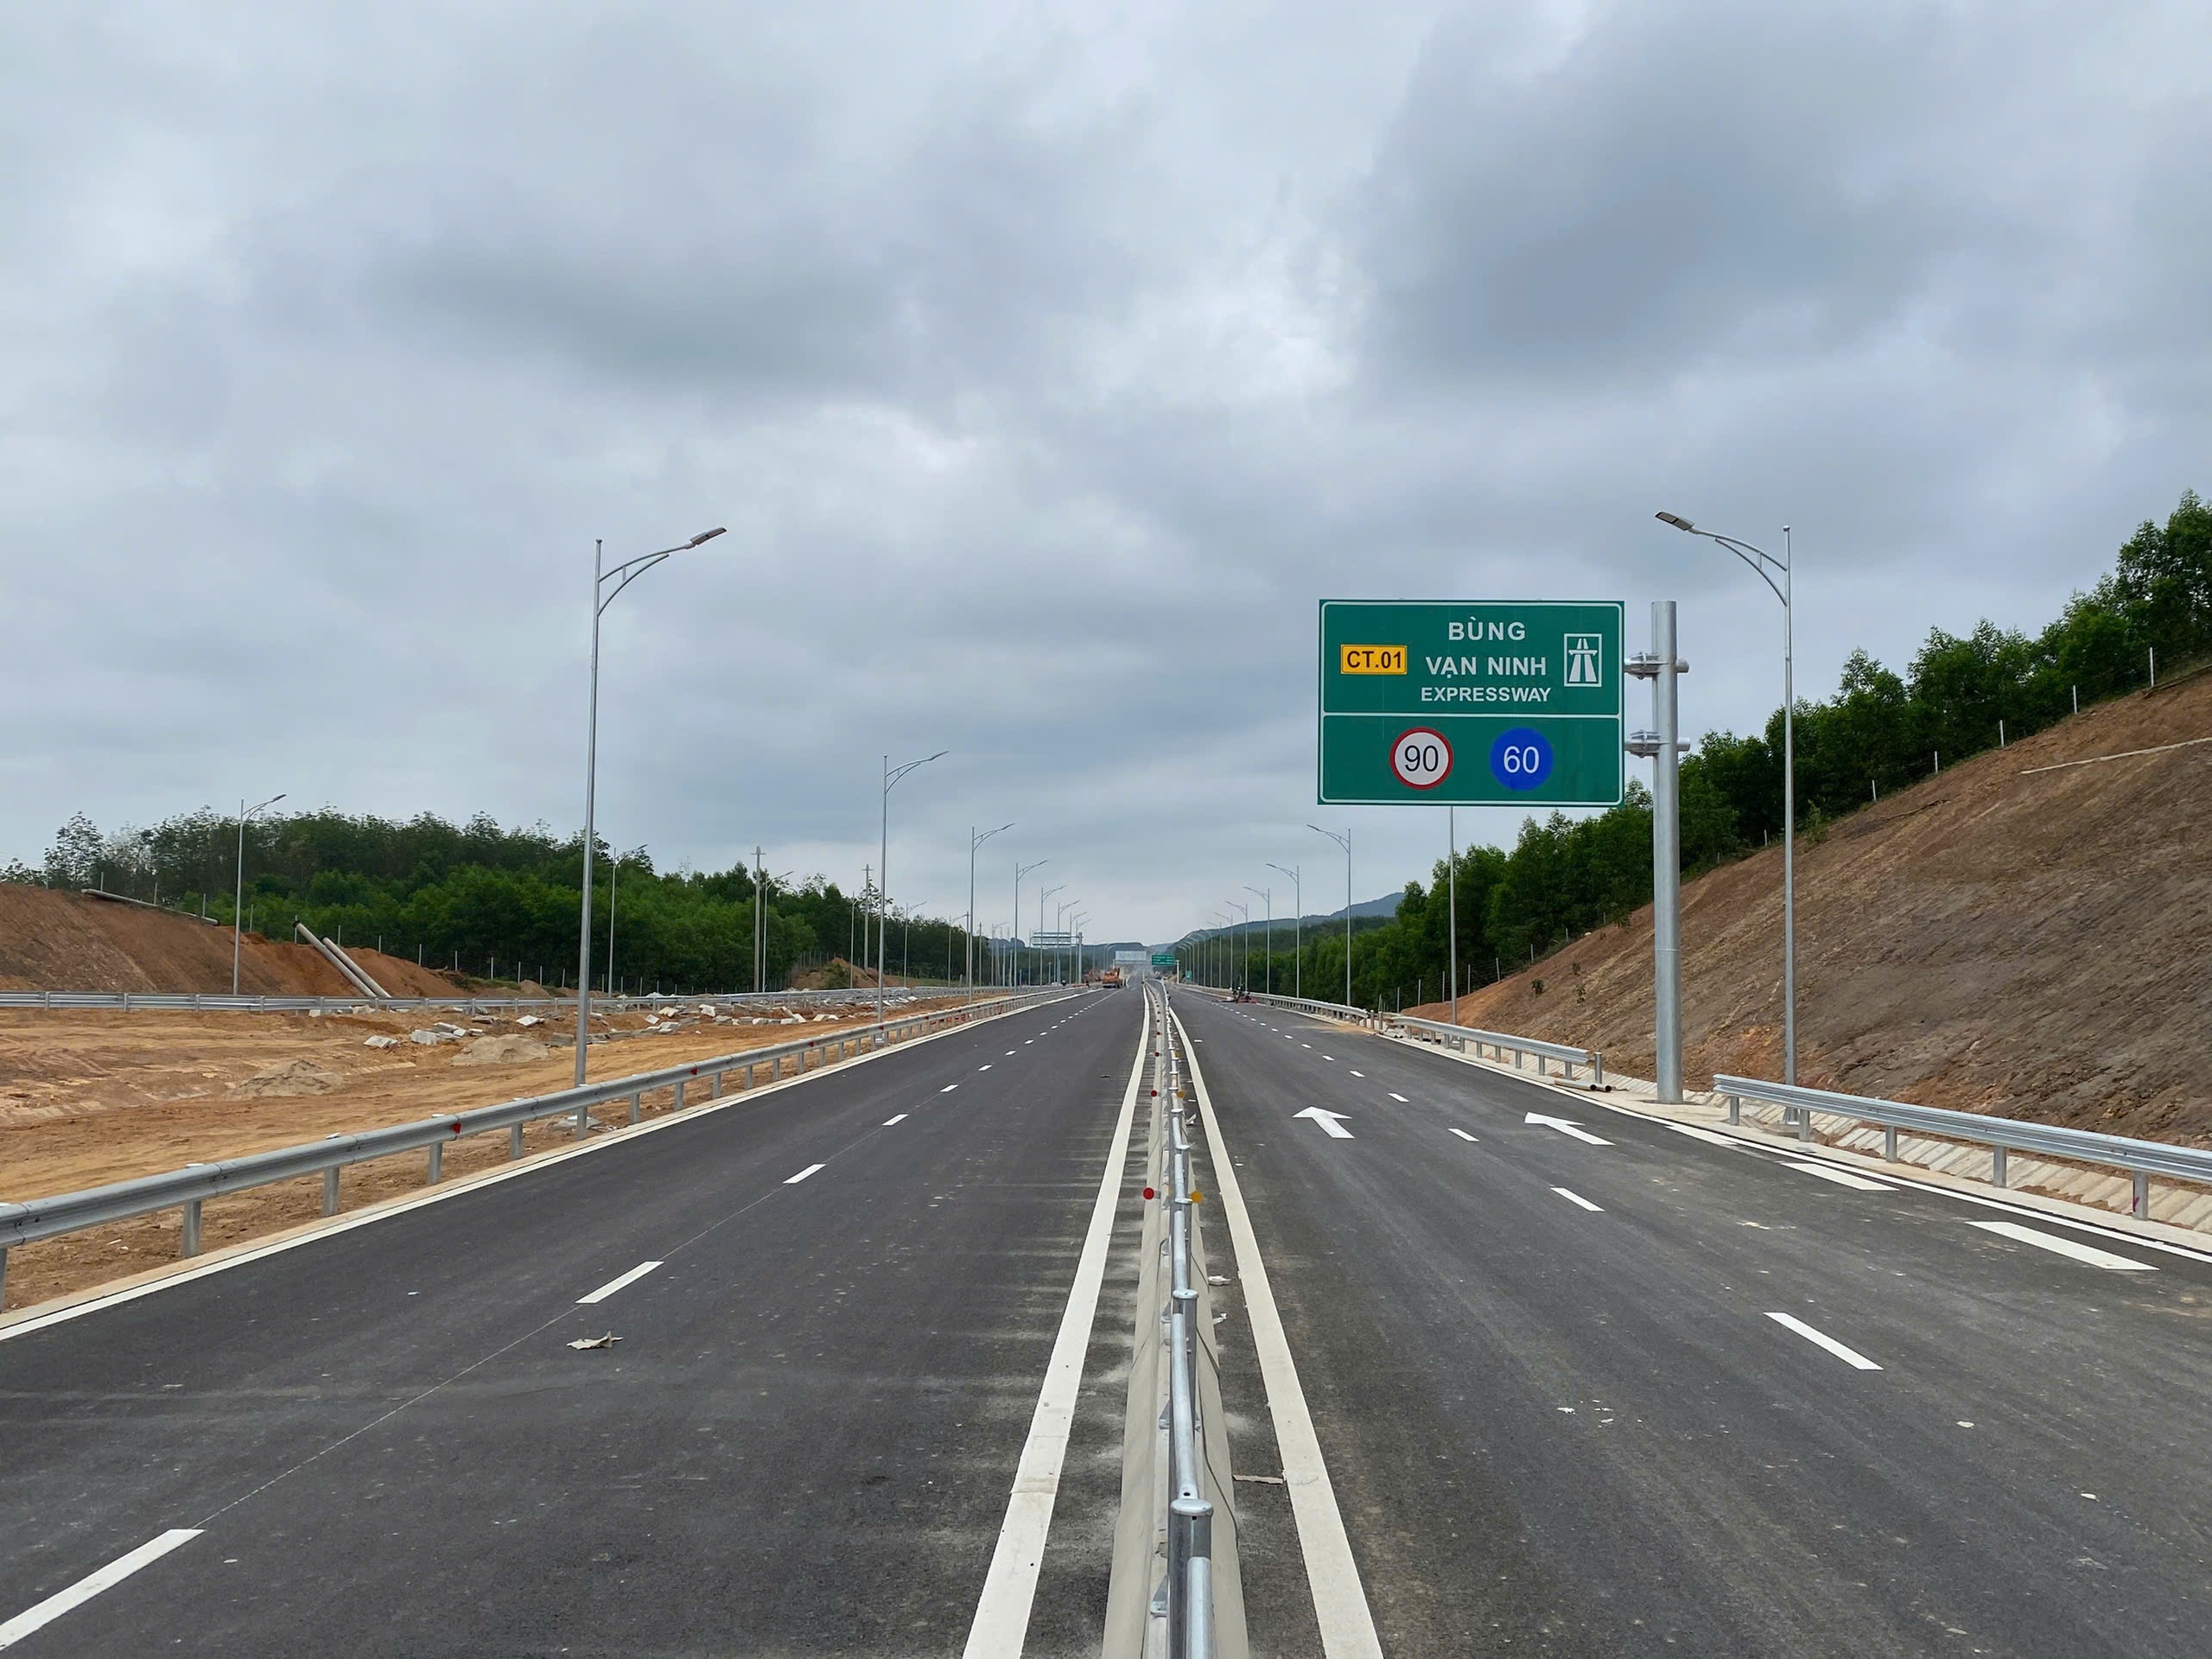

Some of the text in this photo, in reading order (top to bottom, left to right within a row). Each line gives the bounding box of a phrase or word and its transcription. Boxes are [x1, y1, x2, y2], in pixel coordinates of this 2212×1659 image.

[1448, 616, 1526, 641] BÙNG
[1346, 651, 1402, 670] CT.01
[1426, 657, 1547, 678] VẠN NINH
[1421, 687, 1551, 702] EXPRESSWAY
[1404, 745, 1440, 772] 90
[1503, 746, 1540, 773] 60
